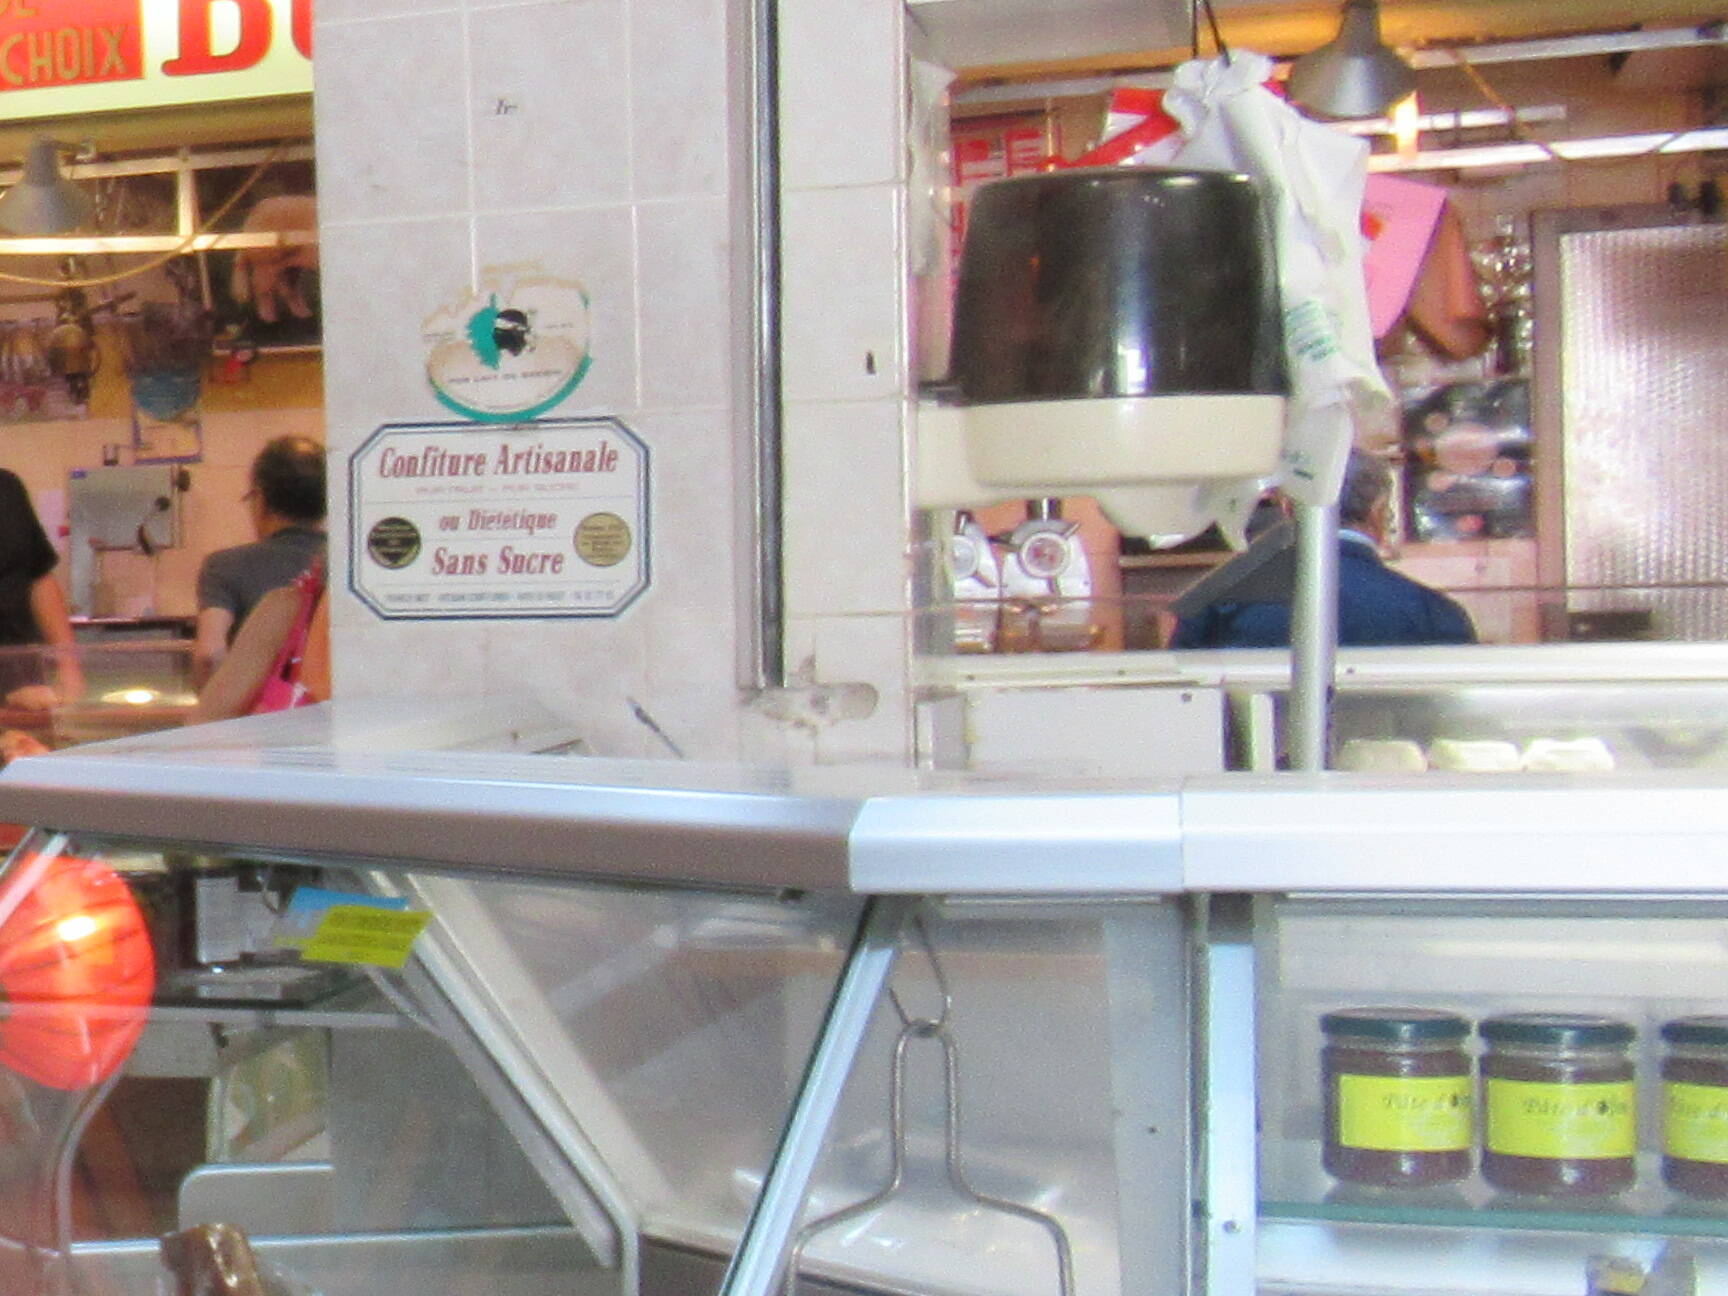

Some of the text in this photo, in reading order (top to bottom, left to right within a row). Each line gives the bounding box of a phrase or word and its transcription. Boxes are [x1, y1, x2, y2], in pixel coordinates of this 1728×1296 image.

[380, 441, 619, 479] Confiture Artisanale
[438, 515, 460, 532] ou
[432, 545, 564, 576] Sans Sucre
